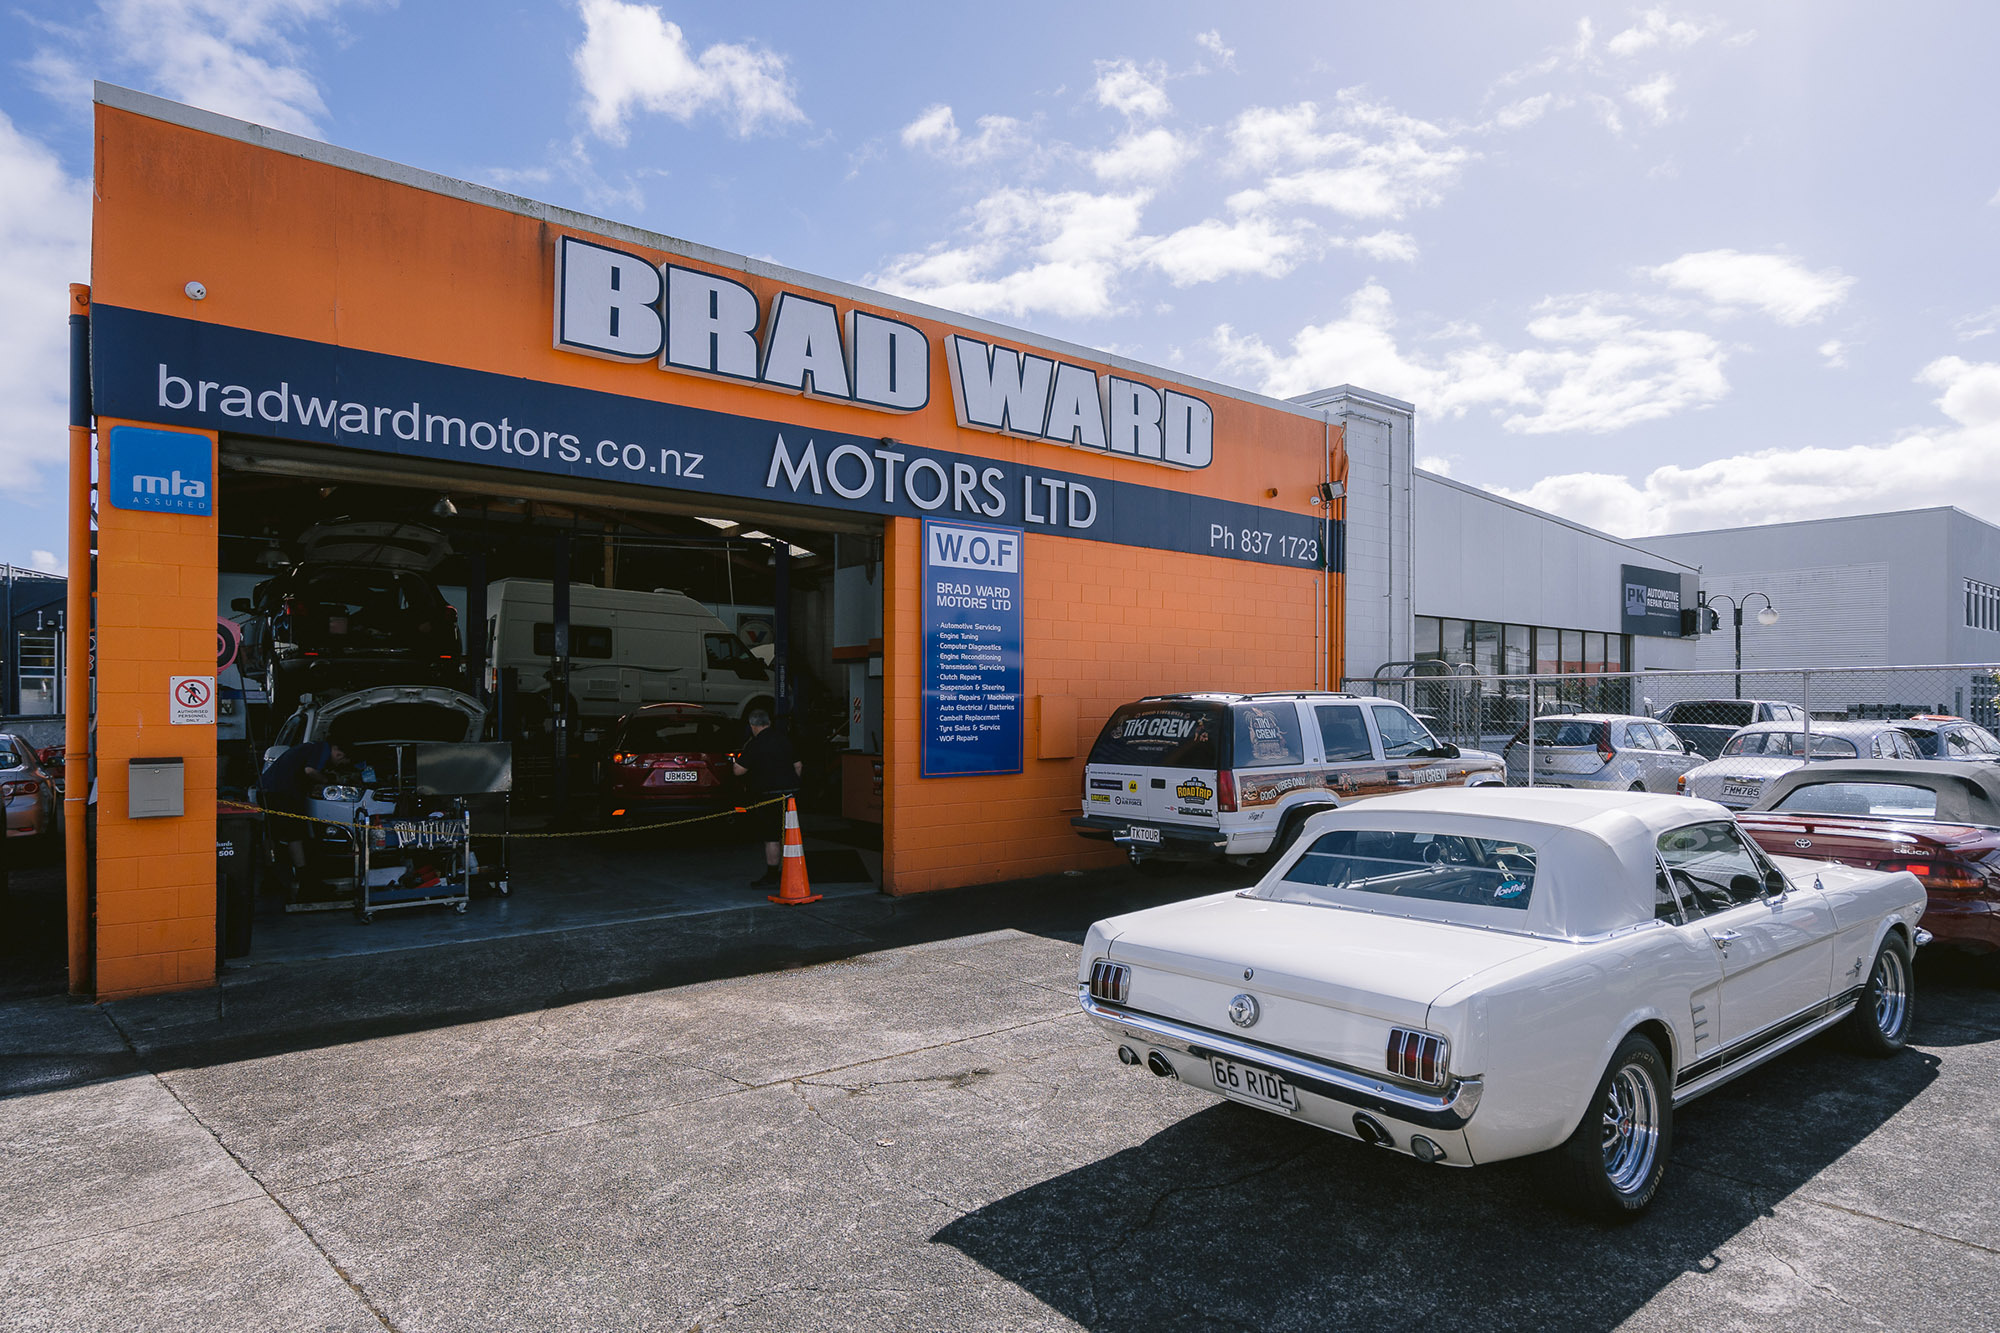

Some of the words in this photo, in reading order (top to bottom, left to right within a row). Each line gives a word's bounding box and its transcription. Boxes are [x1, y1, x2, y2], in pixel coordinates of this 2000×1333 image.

[555, 235, 931, 413] BRAD
[946, 334, 1214, 470] WARD
[158, 363, 705, 479] bradwardmotors.co.nz
[132, 470, 205, 498] mta
[766, 433, 1007, 518] MOTORS
[1024, 475, 1097, 529] LTD
[132, 496, 205, 509] ASSURED
[935, 532, 1013, 567] W.O.F
[1210, 523, 1235, 550] Ph
[1241, 528, 1273, 555] 837
[1279, 535, 1318, 562] 1723
[936, 582, 972, 596] BRAD
[975, 585, 1011, 599] WARD
[1627, 587, 1645, 603] PK
[1646, 587, 1679, 602] AUTOMOTIVE
[936, 595, 987, 609] MOTORS
[991, 599, 1012, 611] LTD
[1646, 598, 1662, 608] REPAIR
[1662, 600, 1679, 611] CENTRE
[940, 622, 973, 630] Automotive
[974, 623, 1002, 632] Servicing
[939, 632, 959, 641] Engine
[960, 633, 979, 641] Tuning
[939, 642, 968, 651] Computer
[968, 643, 1002, 651] Diagnostics
[939, 653, 959, 661] Engine
[960, 653, 1002, 662] Reconditioning
[939, 663, 977, 671] Transmission
[978, 664, 1006, 672] Servicing
[939, 673, 958, 681] Clutch
[959, 673, 982, 682] Repairs
[939, 683, 973, 692] Suspension
[981, 684, 1006, 692] Steering
[958, 694, 981, 702] Repairs
[986, 694, 1015, 702] Machining
[939, 714, 964, 722] Cambelt
[964, 714, 1001, 722] Replacement
[939, 725, 953, 733] Tyre
[954, 724, 971, 732] Sales
[1147, 717, 1196, 738] CREW
[1255, 728, 1277, 739] CREW
[665, 772, 697, 780] JBM855
[1425, 768, 1447, 782] CREW
[1260, 788, 1277, 801] GOOD
[1275, 778, 1293, 793] VIBES
[1291, 776, 1306, 787] ONLY
[1131, 827, 1159, 841] TKTOUR
[1214, 1061, 1239, 1088] 66
[1245, 1069, 1293, 1105] RIDE
